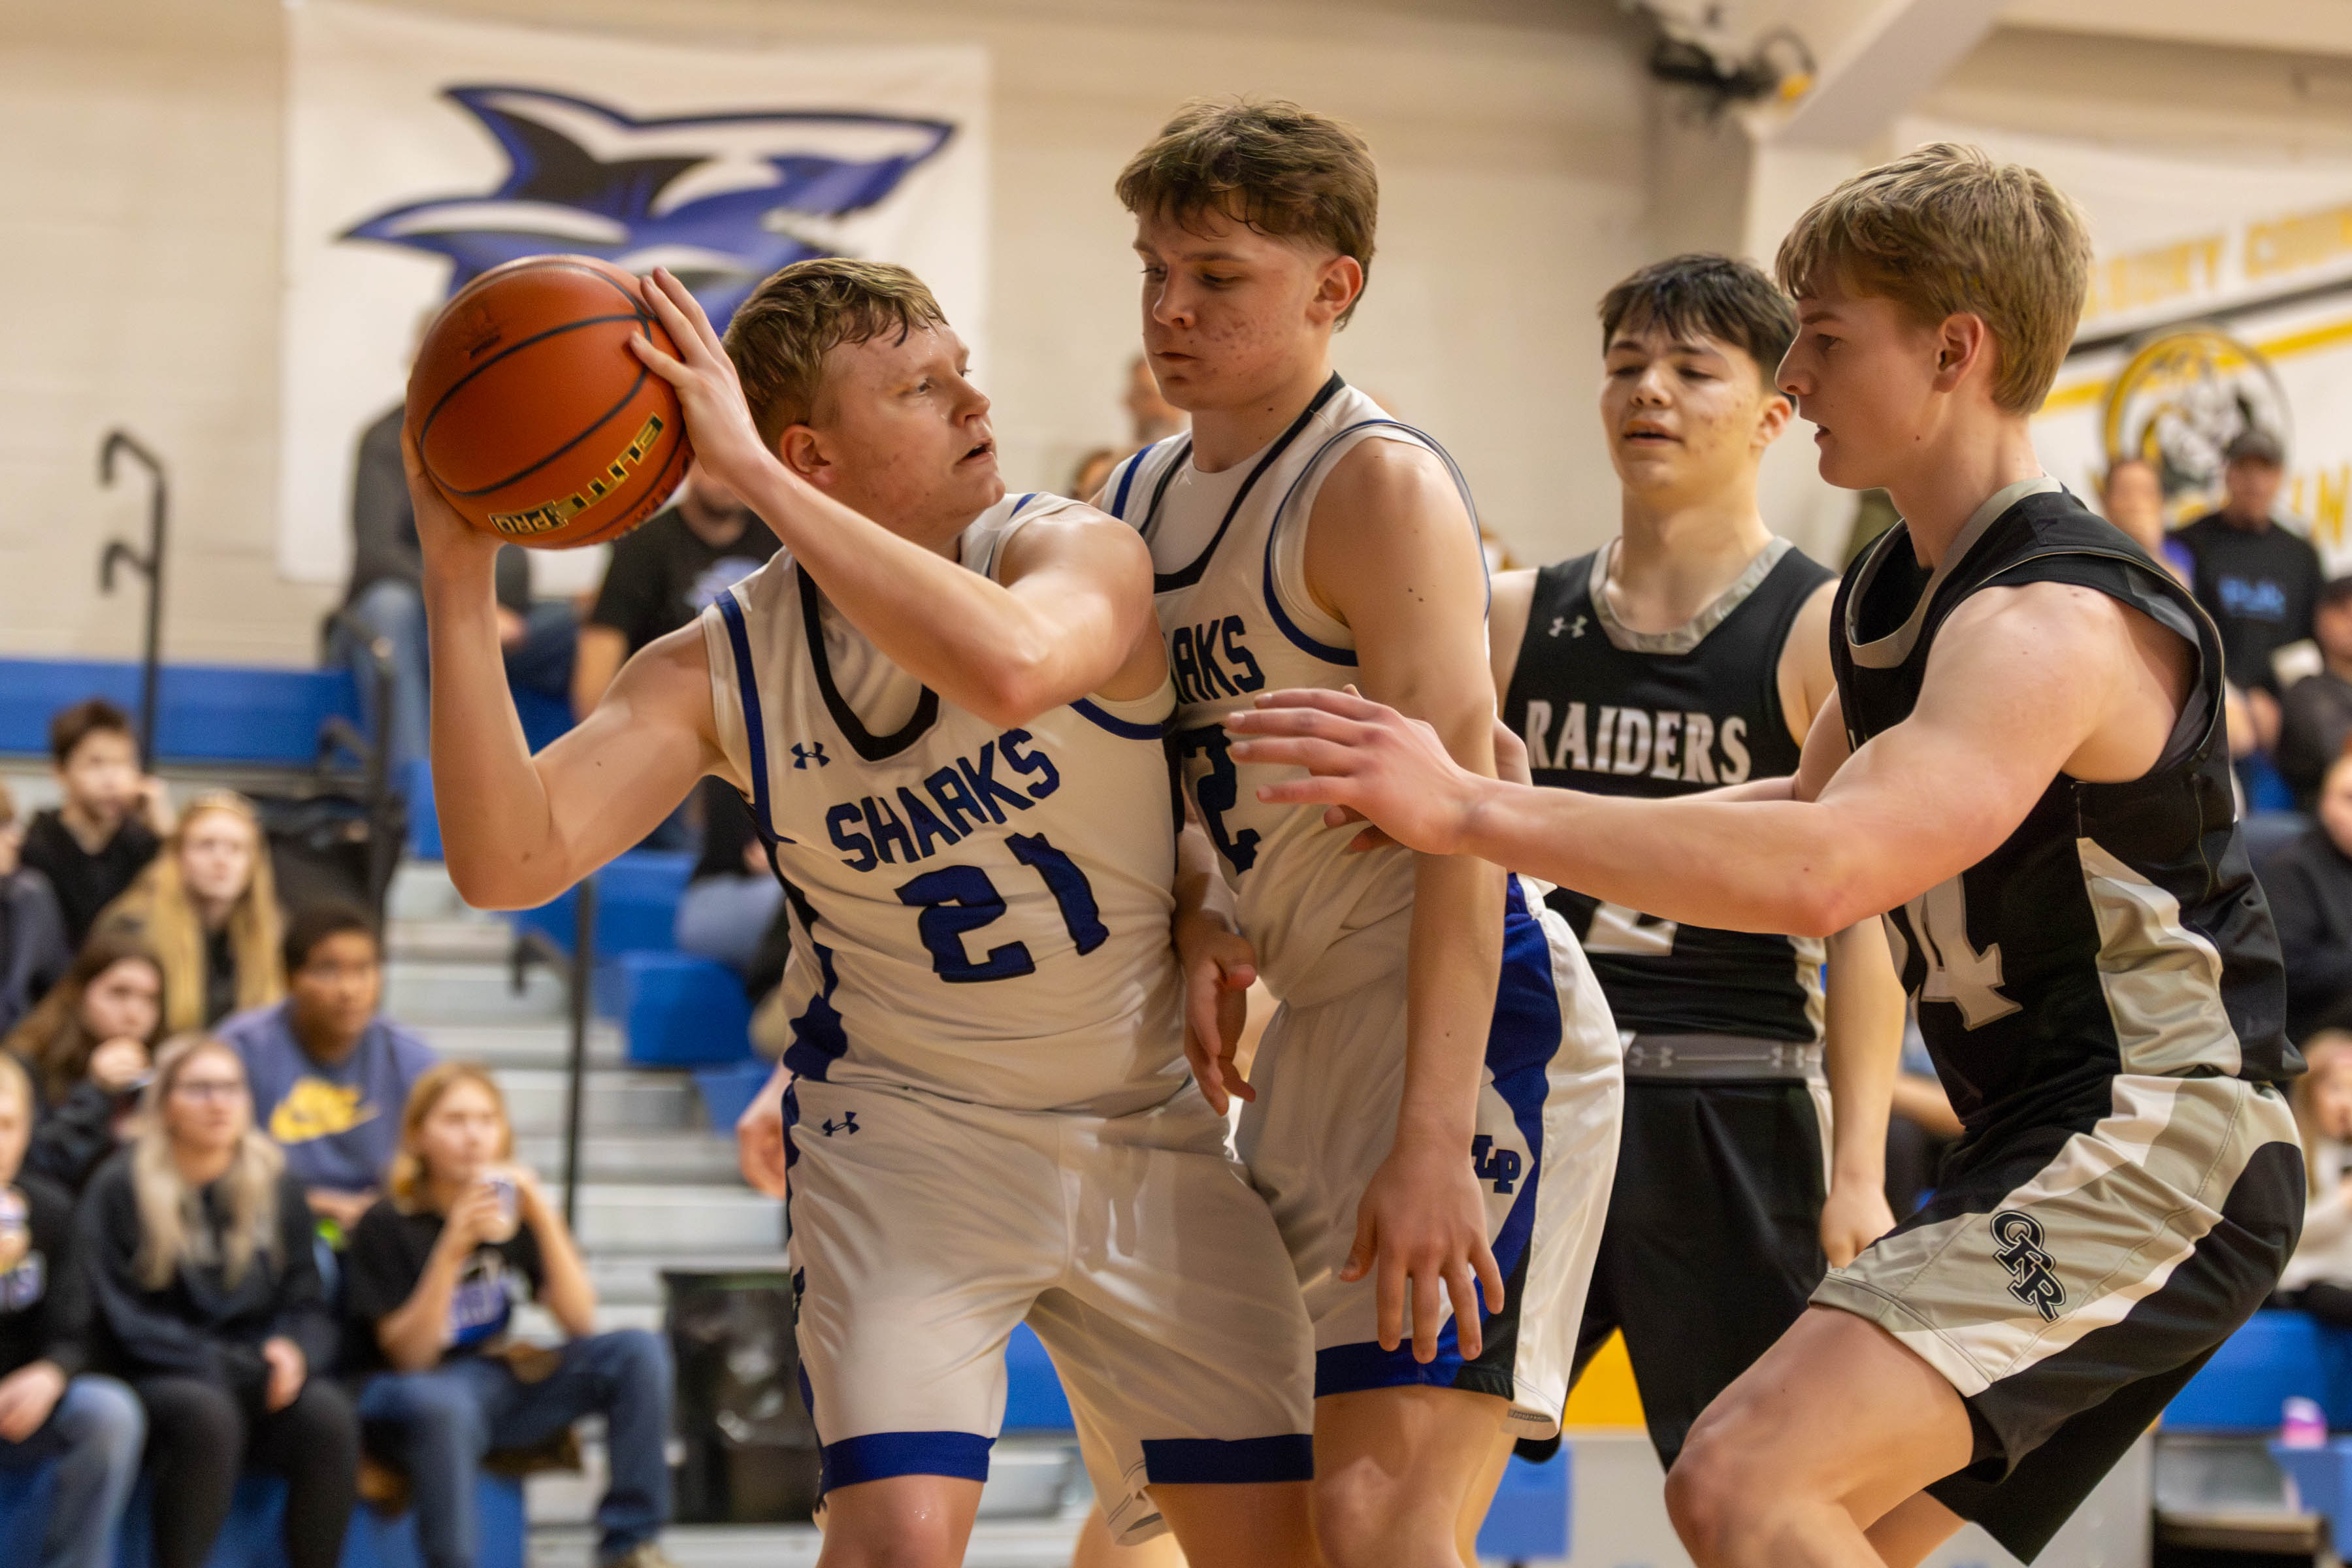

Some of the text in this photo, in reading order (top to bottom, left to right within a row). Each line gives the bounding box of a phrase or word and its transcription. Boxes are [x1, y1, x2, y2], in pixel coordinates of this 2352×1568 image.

[491, 504, 557, 534] PRO
[1524, 700, 1752, 784] RAIDERS
[826, 728, 1060, 872] SHARKS
[894, 832, 1109, 983] 21
[1471, 1135, 1521, 1194] LP
